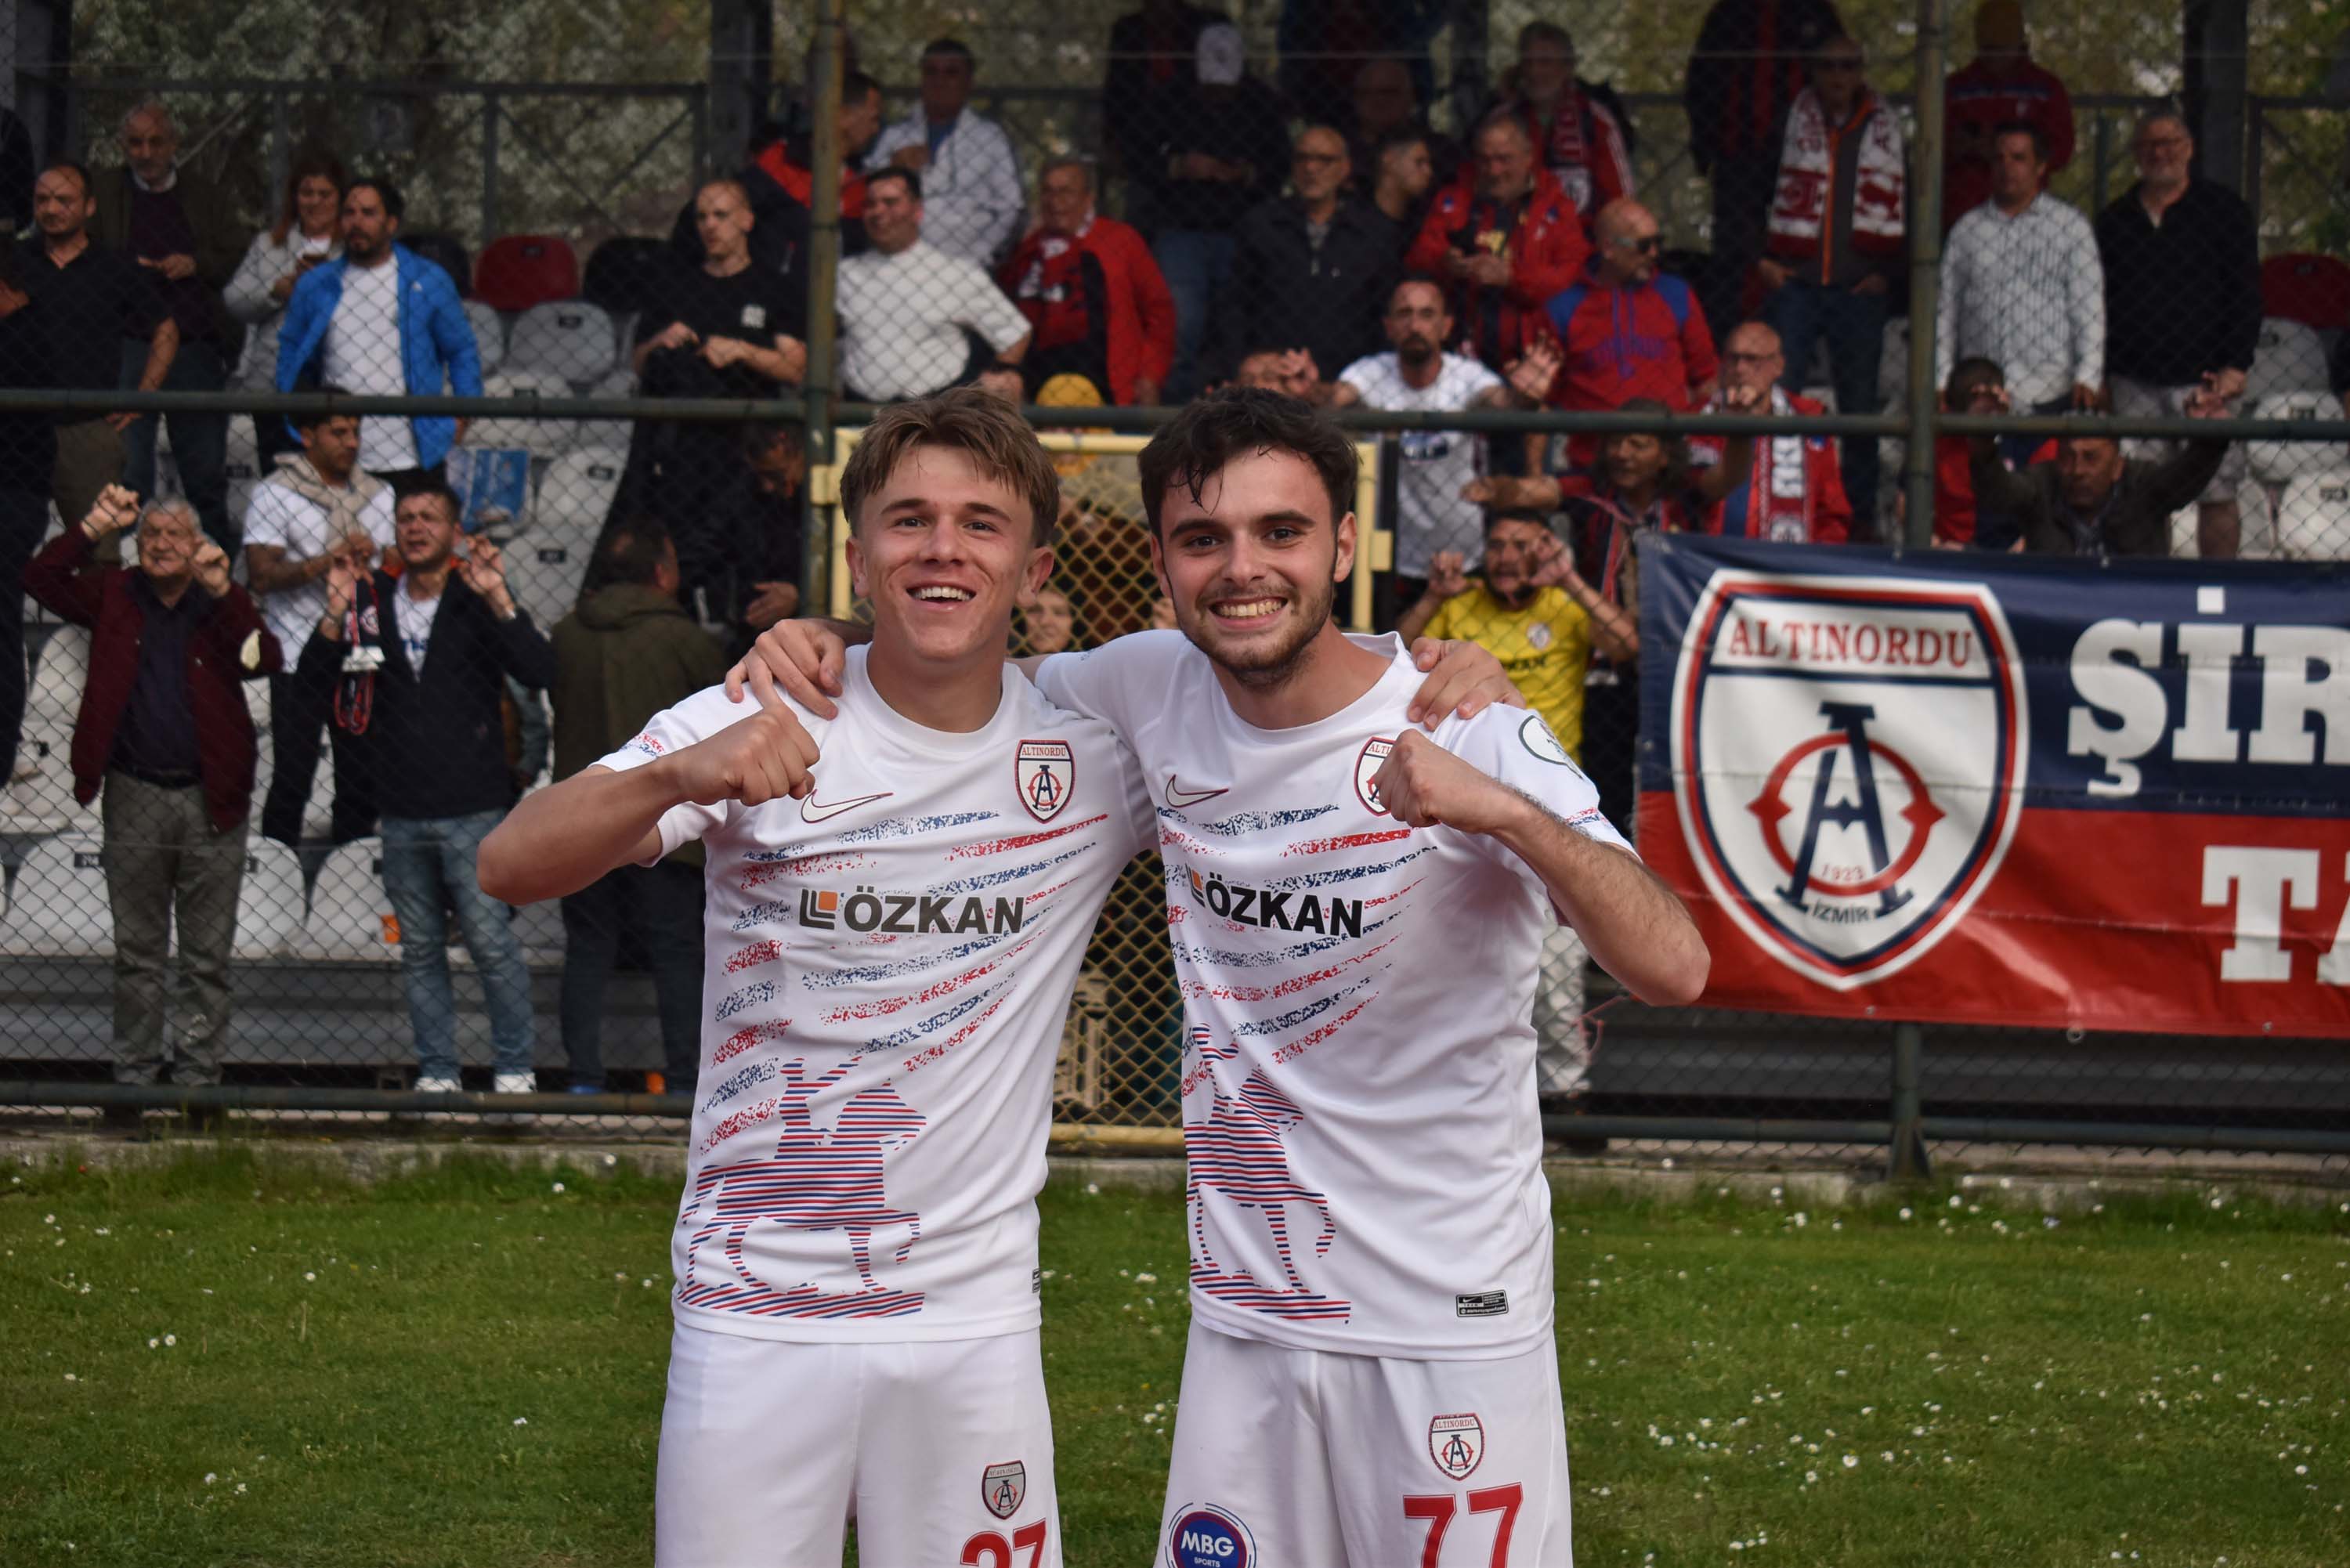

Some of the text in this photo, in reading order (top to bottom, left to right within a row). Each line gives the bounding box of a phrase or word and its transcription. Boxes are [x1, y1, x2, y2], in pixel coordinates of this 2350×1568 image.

[1728, 619, 1972, 669] ALTINORDU
[2066, 586, 2350, 798] ŞİR
[1021, 746, 1066, 757] ALTINORDU
[844, 885, 1025, 934] ÖZKAN
[1205, 872, 1363, 938] ÖZKAN
[2201, 845, 2350, 986] T
[1180, 1530, 1235, 1557] MBG
[1403, 1482, 1524, 1568] 77
